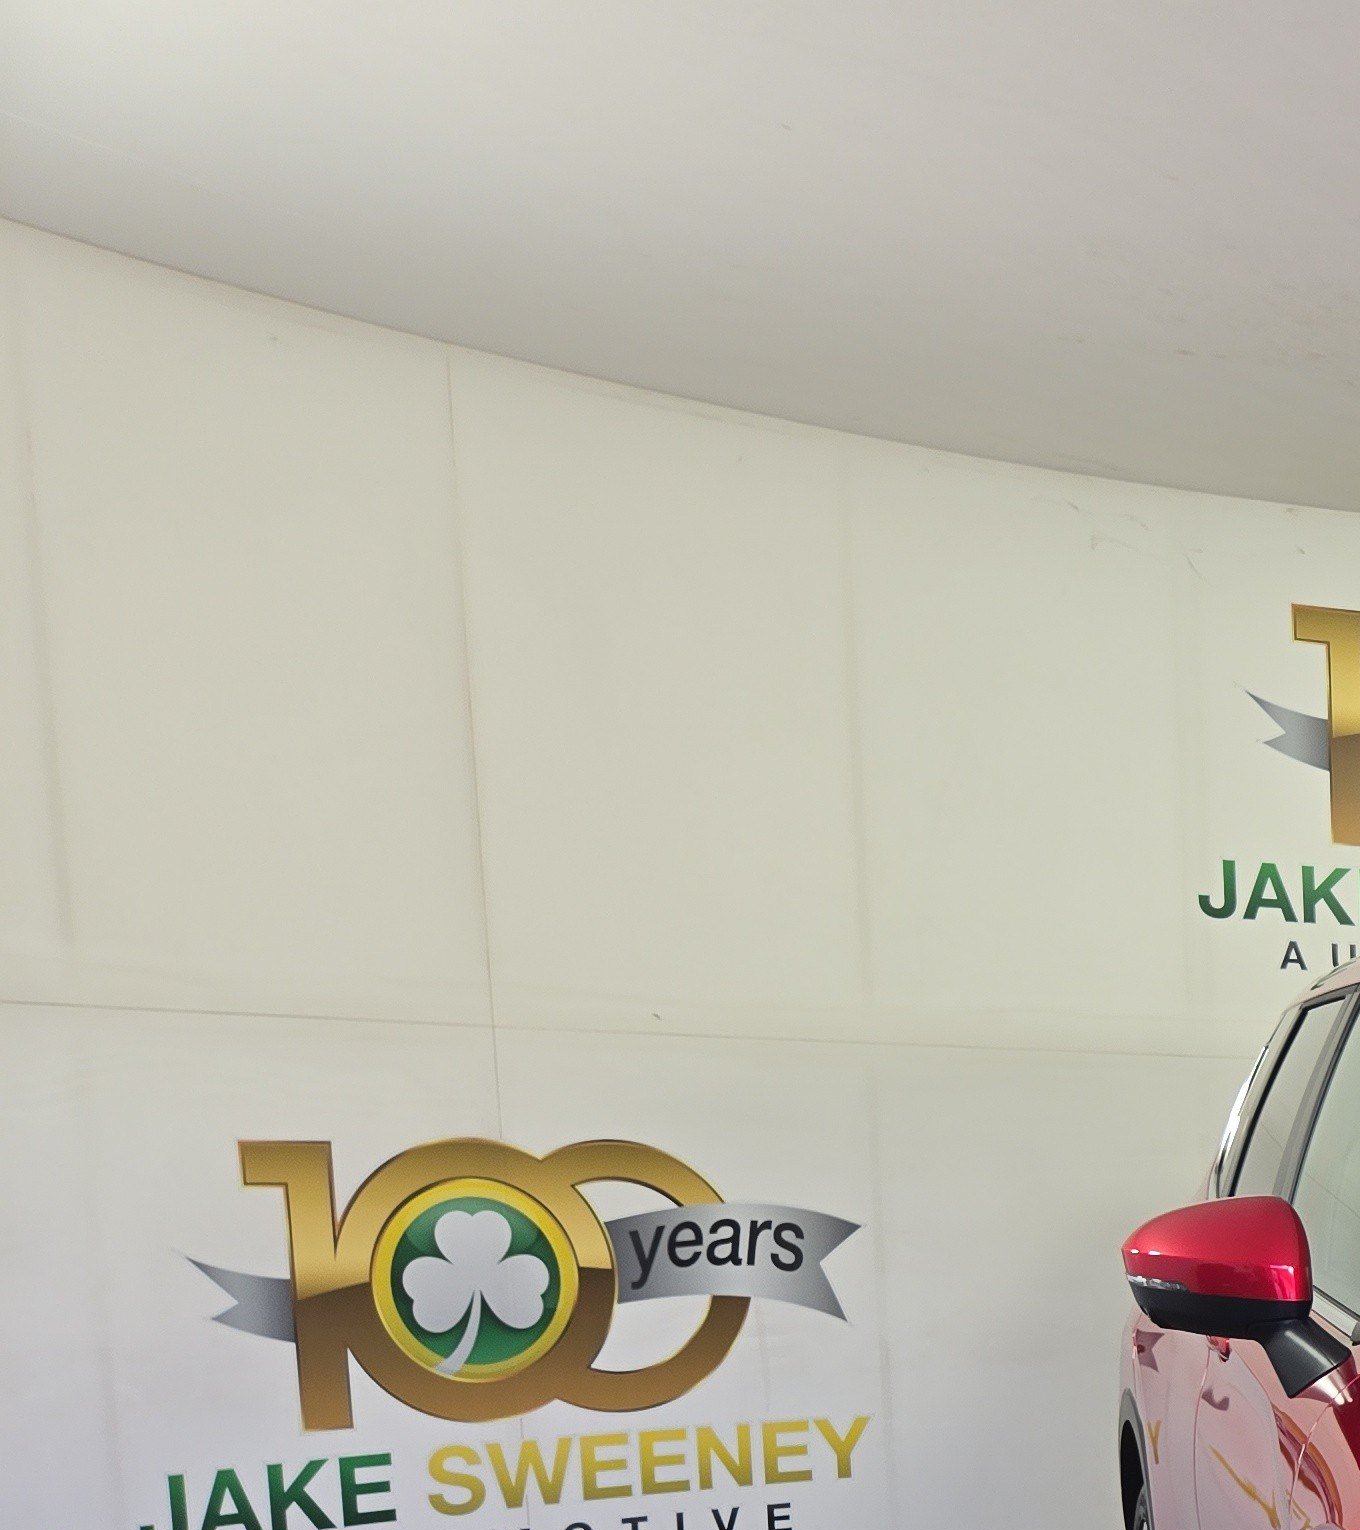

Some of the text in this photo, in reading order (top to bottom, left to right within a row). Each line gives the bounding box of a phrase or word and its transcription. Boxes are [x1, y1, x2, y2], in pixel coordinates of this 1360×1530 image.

[238, 1137, 751, 1432] 100
[628, 1217, 805, 1290] years
[426, 1415, 870, 1517] SWEENEY
